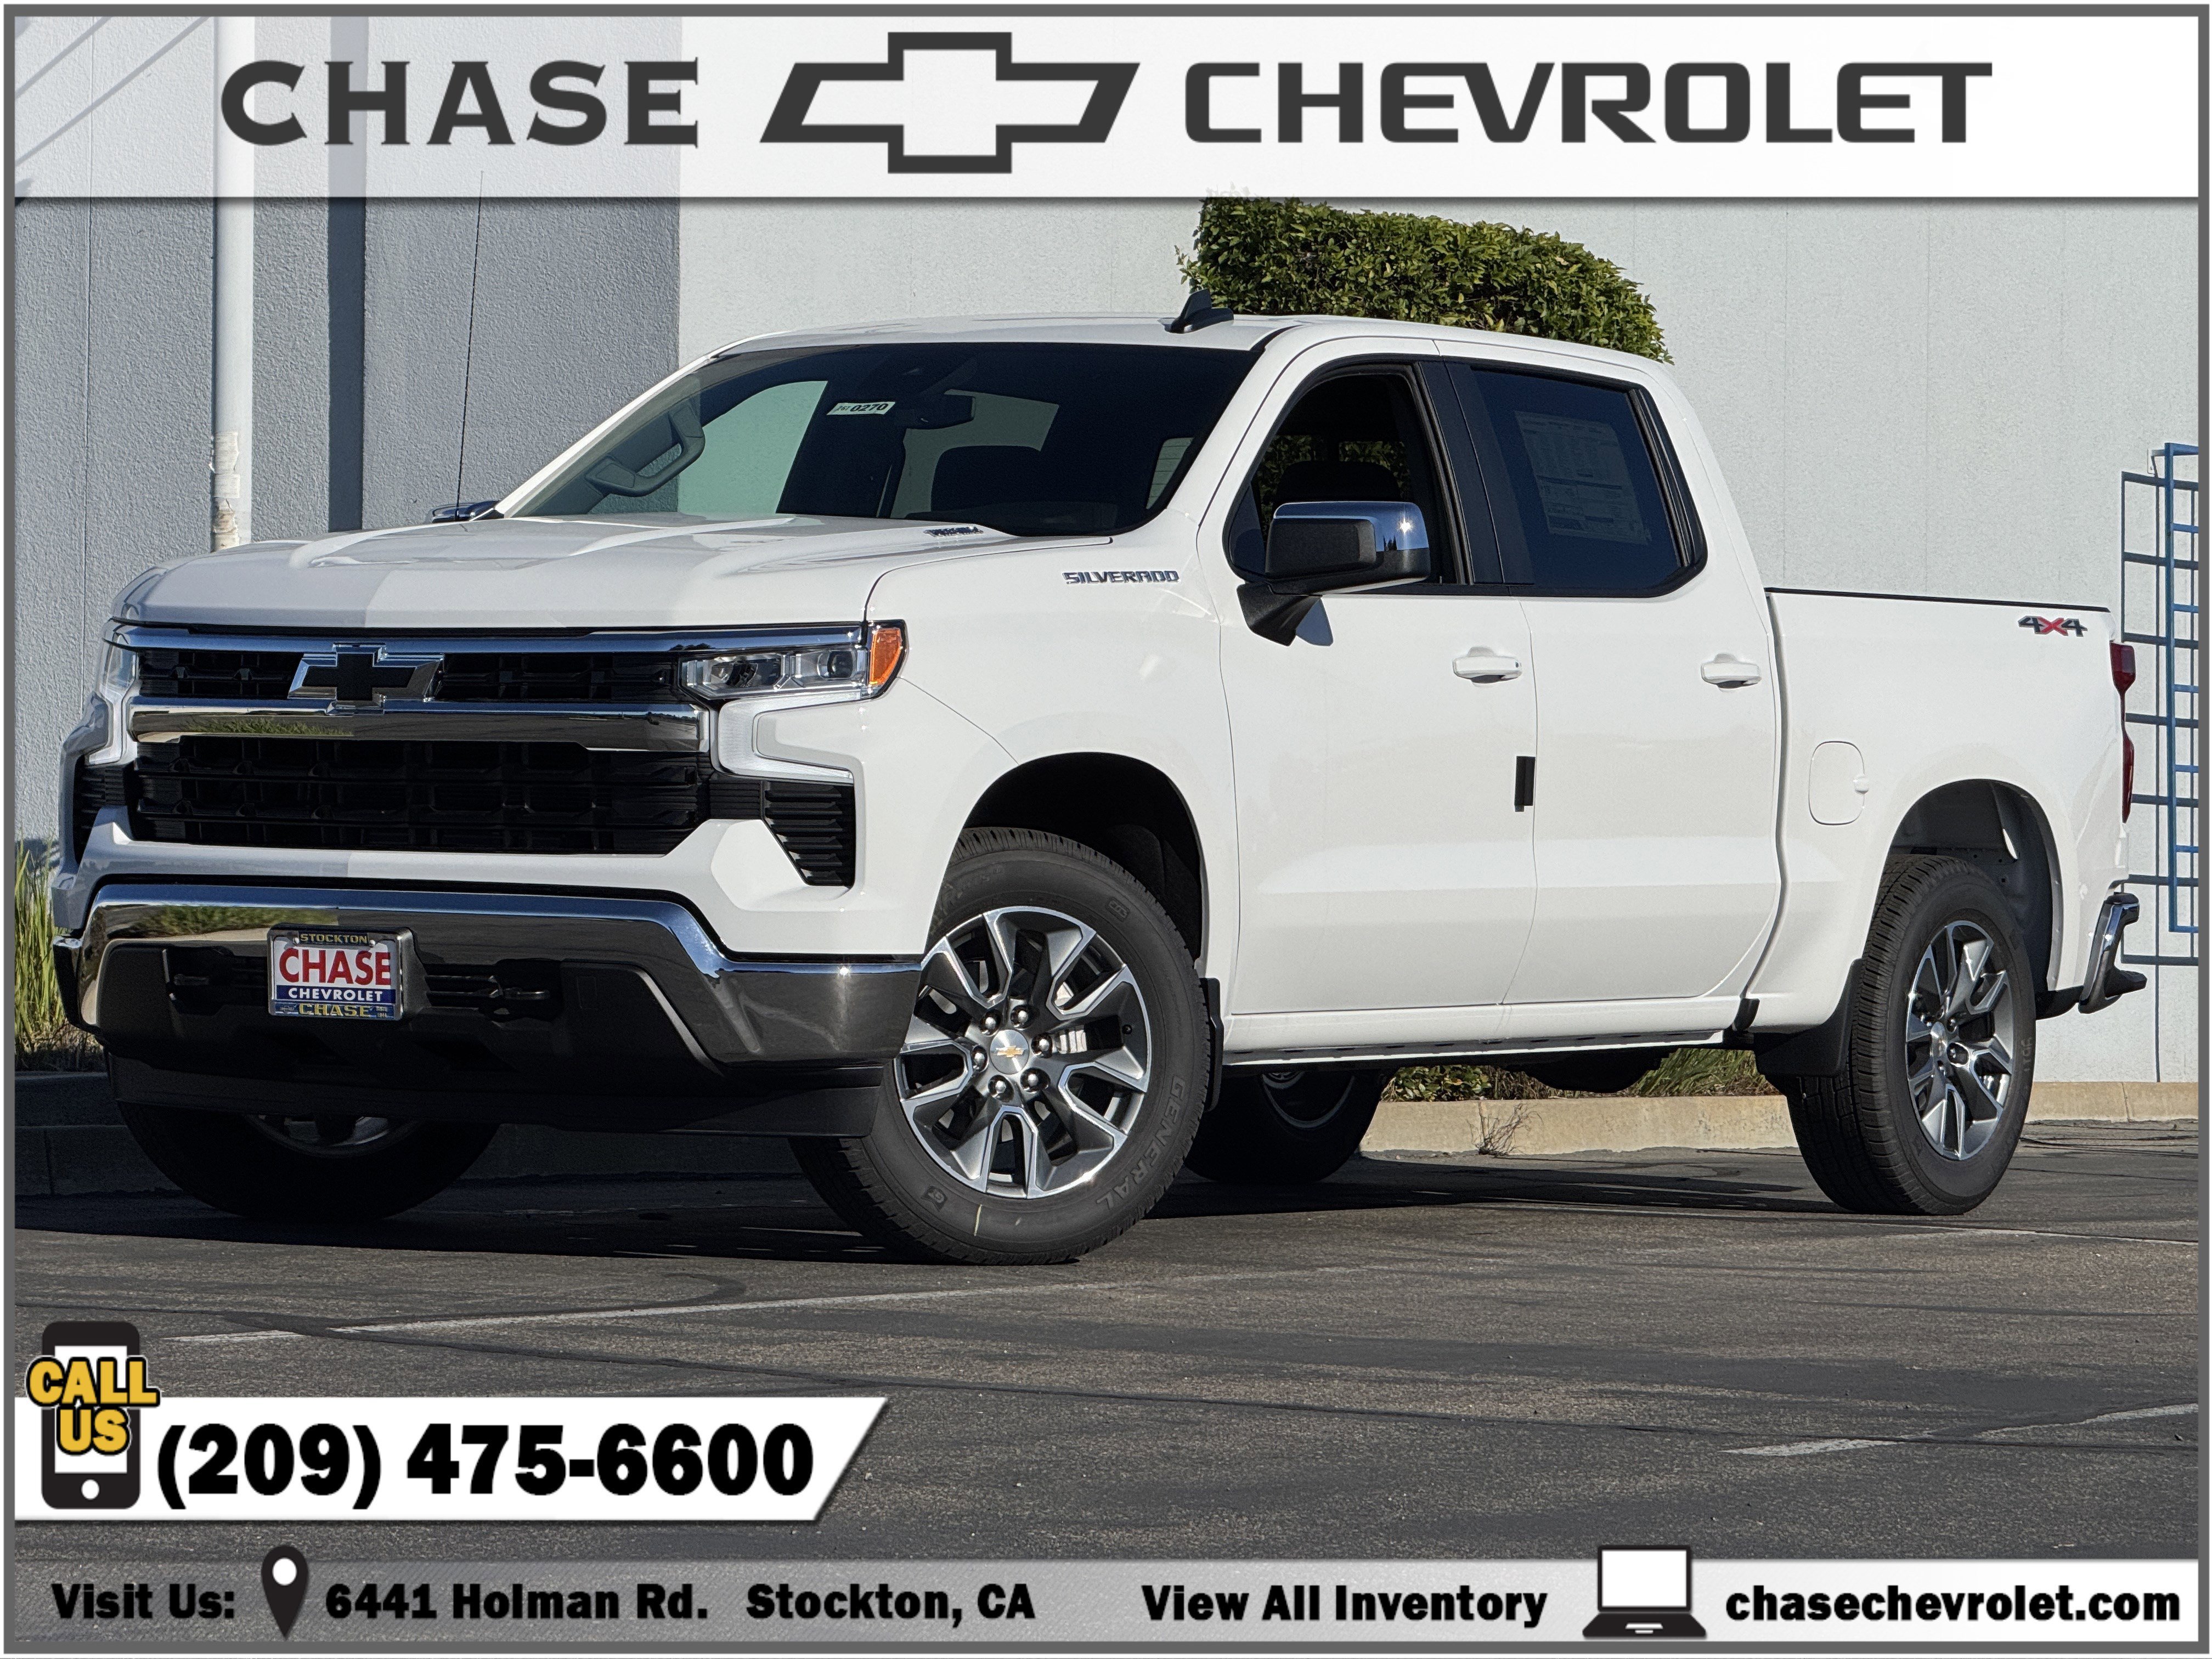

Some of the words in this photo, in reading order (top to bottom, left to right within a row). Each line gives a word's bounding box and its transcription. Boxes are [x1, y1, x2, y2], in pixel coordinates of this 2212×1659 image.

[850, 403, 889, 412] 0270
[1062, 571, 1180, 584] SILVERADO
[300, 933, 368, 944] STOCKTON
[279, 947, 391, 986] CHASE
[288, 988, 383, 1002] CHEVROLET
[298, 1003, 371, 1017] CHASE
[1095, 1075, 1186, 1210] GENERAL
